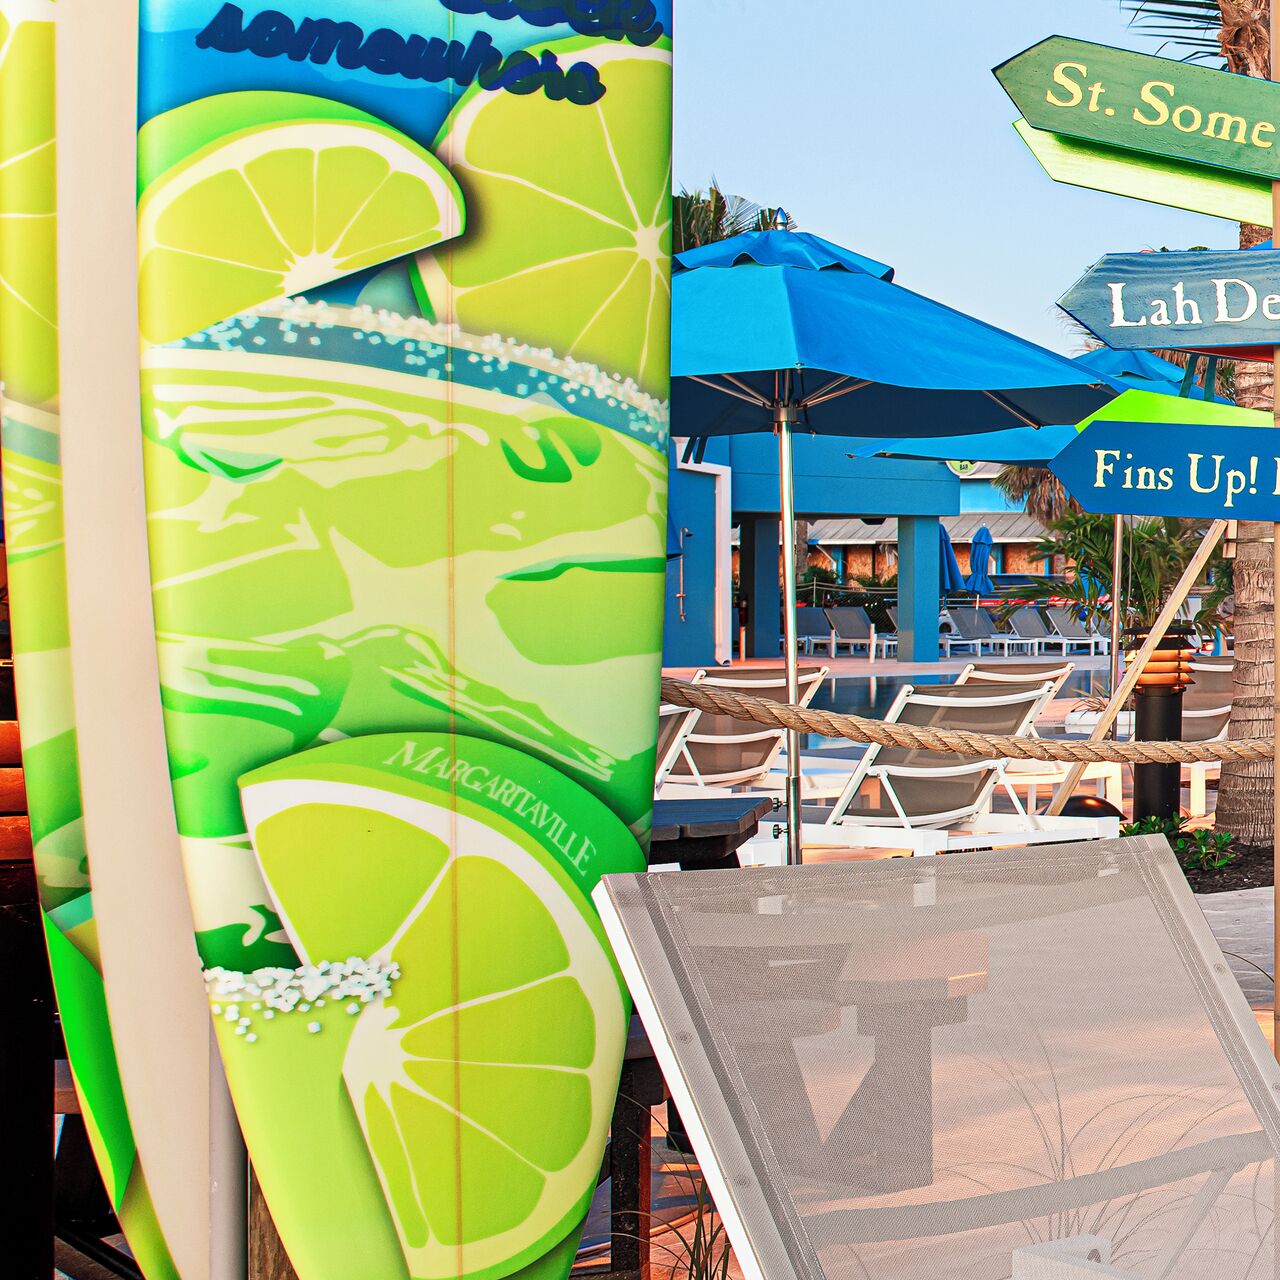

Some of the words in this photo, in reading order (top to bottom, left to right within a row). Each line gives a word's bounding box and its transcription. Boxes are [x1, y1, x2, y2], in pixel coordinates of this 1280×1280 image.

[195, 3, 606, 106] somewhere
[1046, 61, 1115, 117] St.
[1107, 282, 1201, 329] Lah
[1093, 449, 1174, 490] Fins
[1187, 453, 1258, 508] Up!
[383, 740, 598, 877] MARGARITAVILLE
